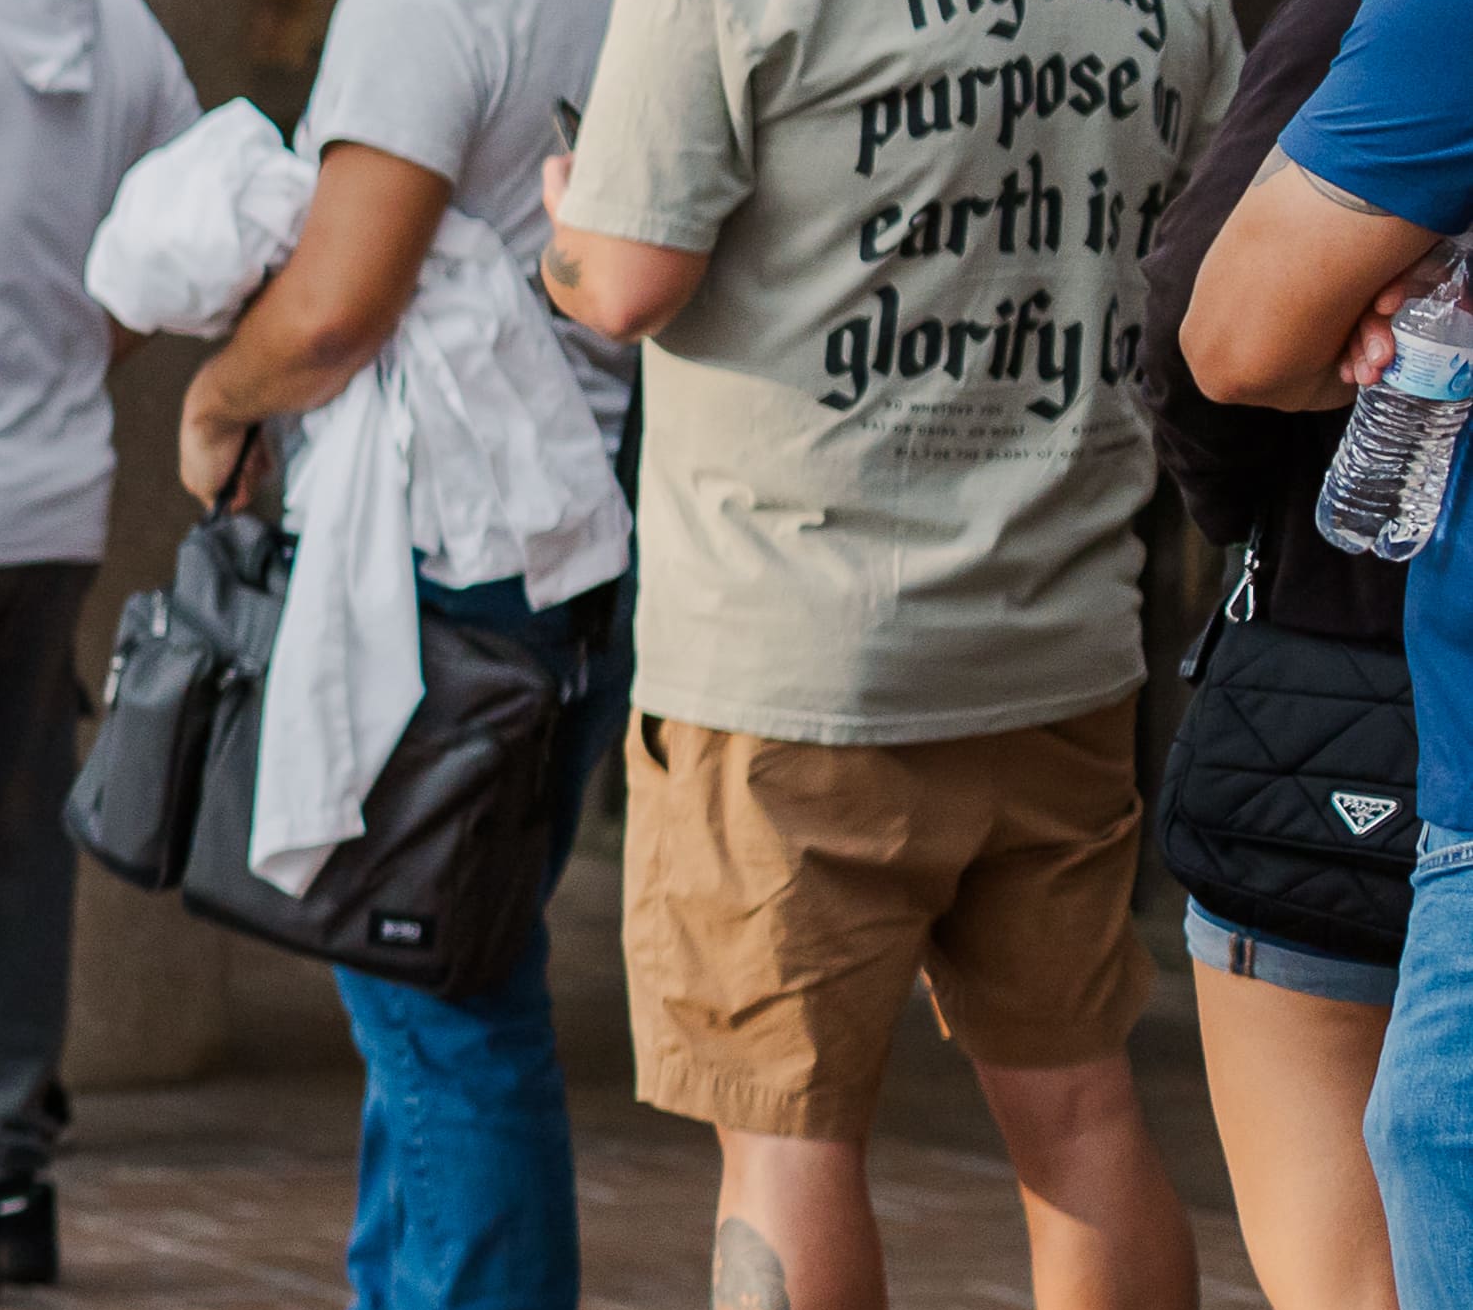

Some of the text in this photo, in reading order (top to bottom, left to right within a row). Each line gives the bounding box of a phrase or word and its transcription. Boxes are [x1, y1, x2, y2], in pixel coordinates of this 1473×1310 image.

[855, 51, 1142, 177] purpose
[859, 151, 1063, 265] earth
[1084, 167, 1124, 258] is
[818, 285, 1085, 422] glorify
